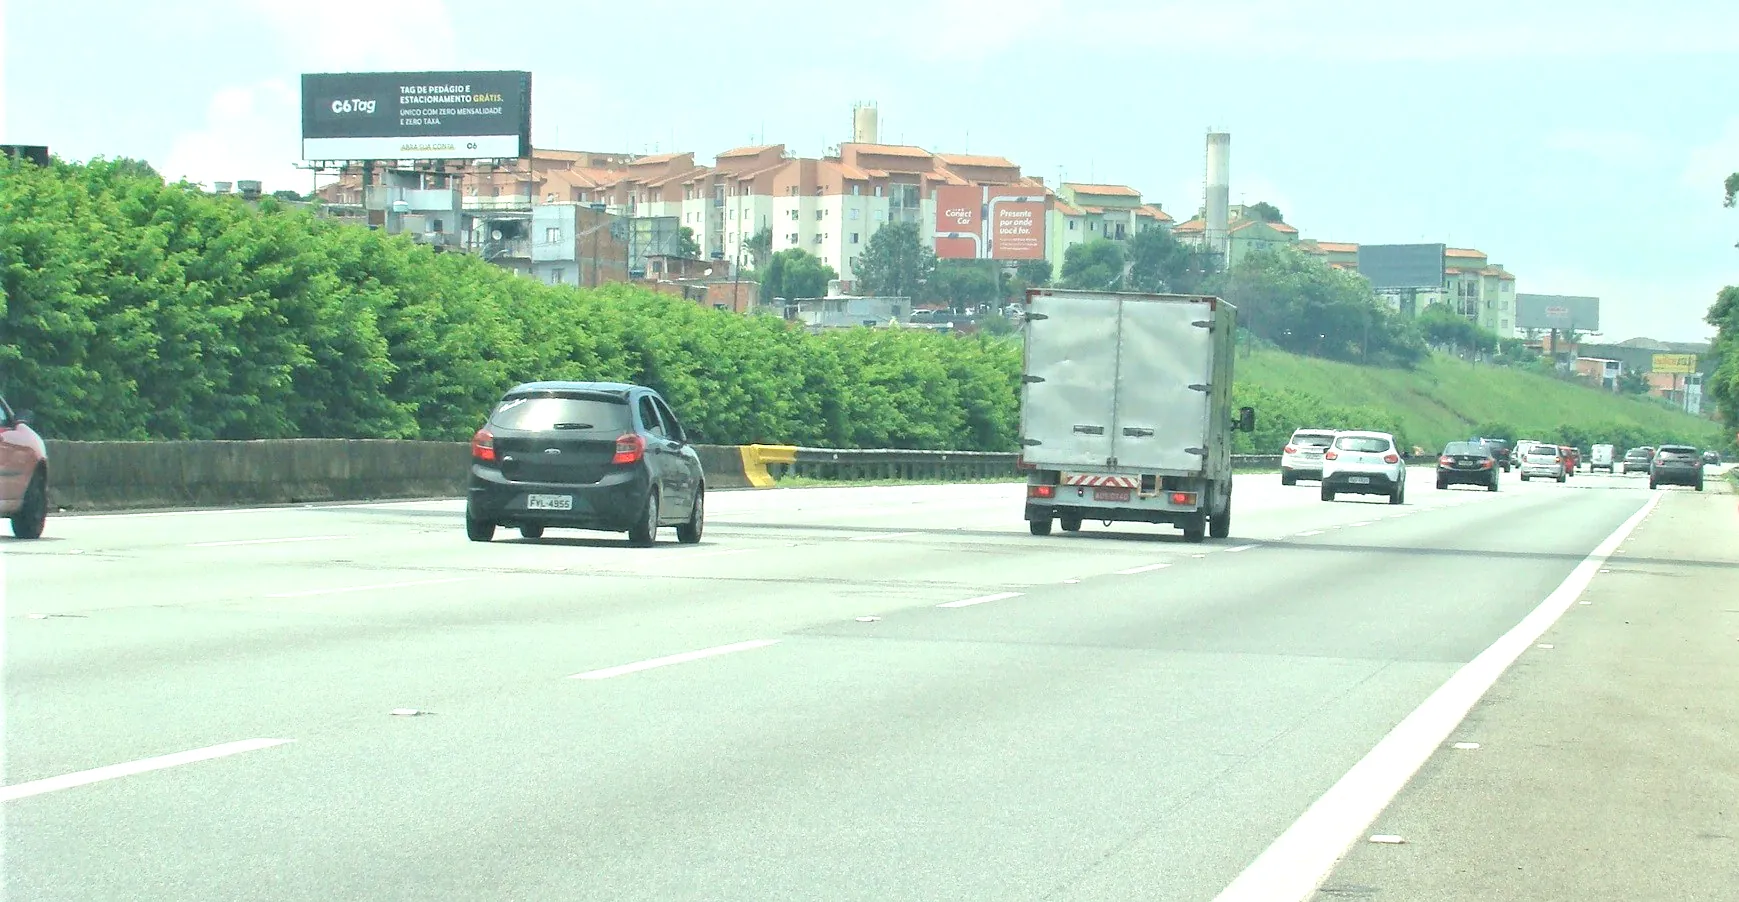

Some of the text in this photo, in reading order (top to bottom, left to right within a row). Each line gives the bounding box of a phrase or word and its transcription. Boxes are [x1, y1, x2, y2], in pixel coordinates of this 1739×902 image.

[429, 85, 464, 93] PEDÁGIO
[400, 93, 504, 103] ESTACIONAMENTO GRÁTIS.
[332, 99, 376, 113] C6 Tag
[400, 108, 421, 116] ÚNICO
[945, 209, 972, 218] Conect
